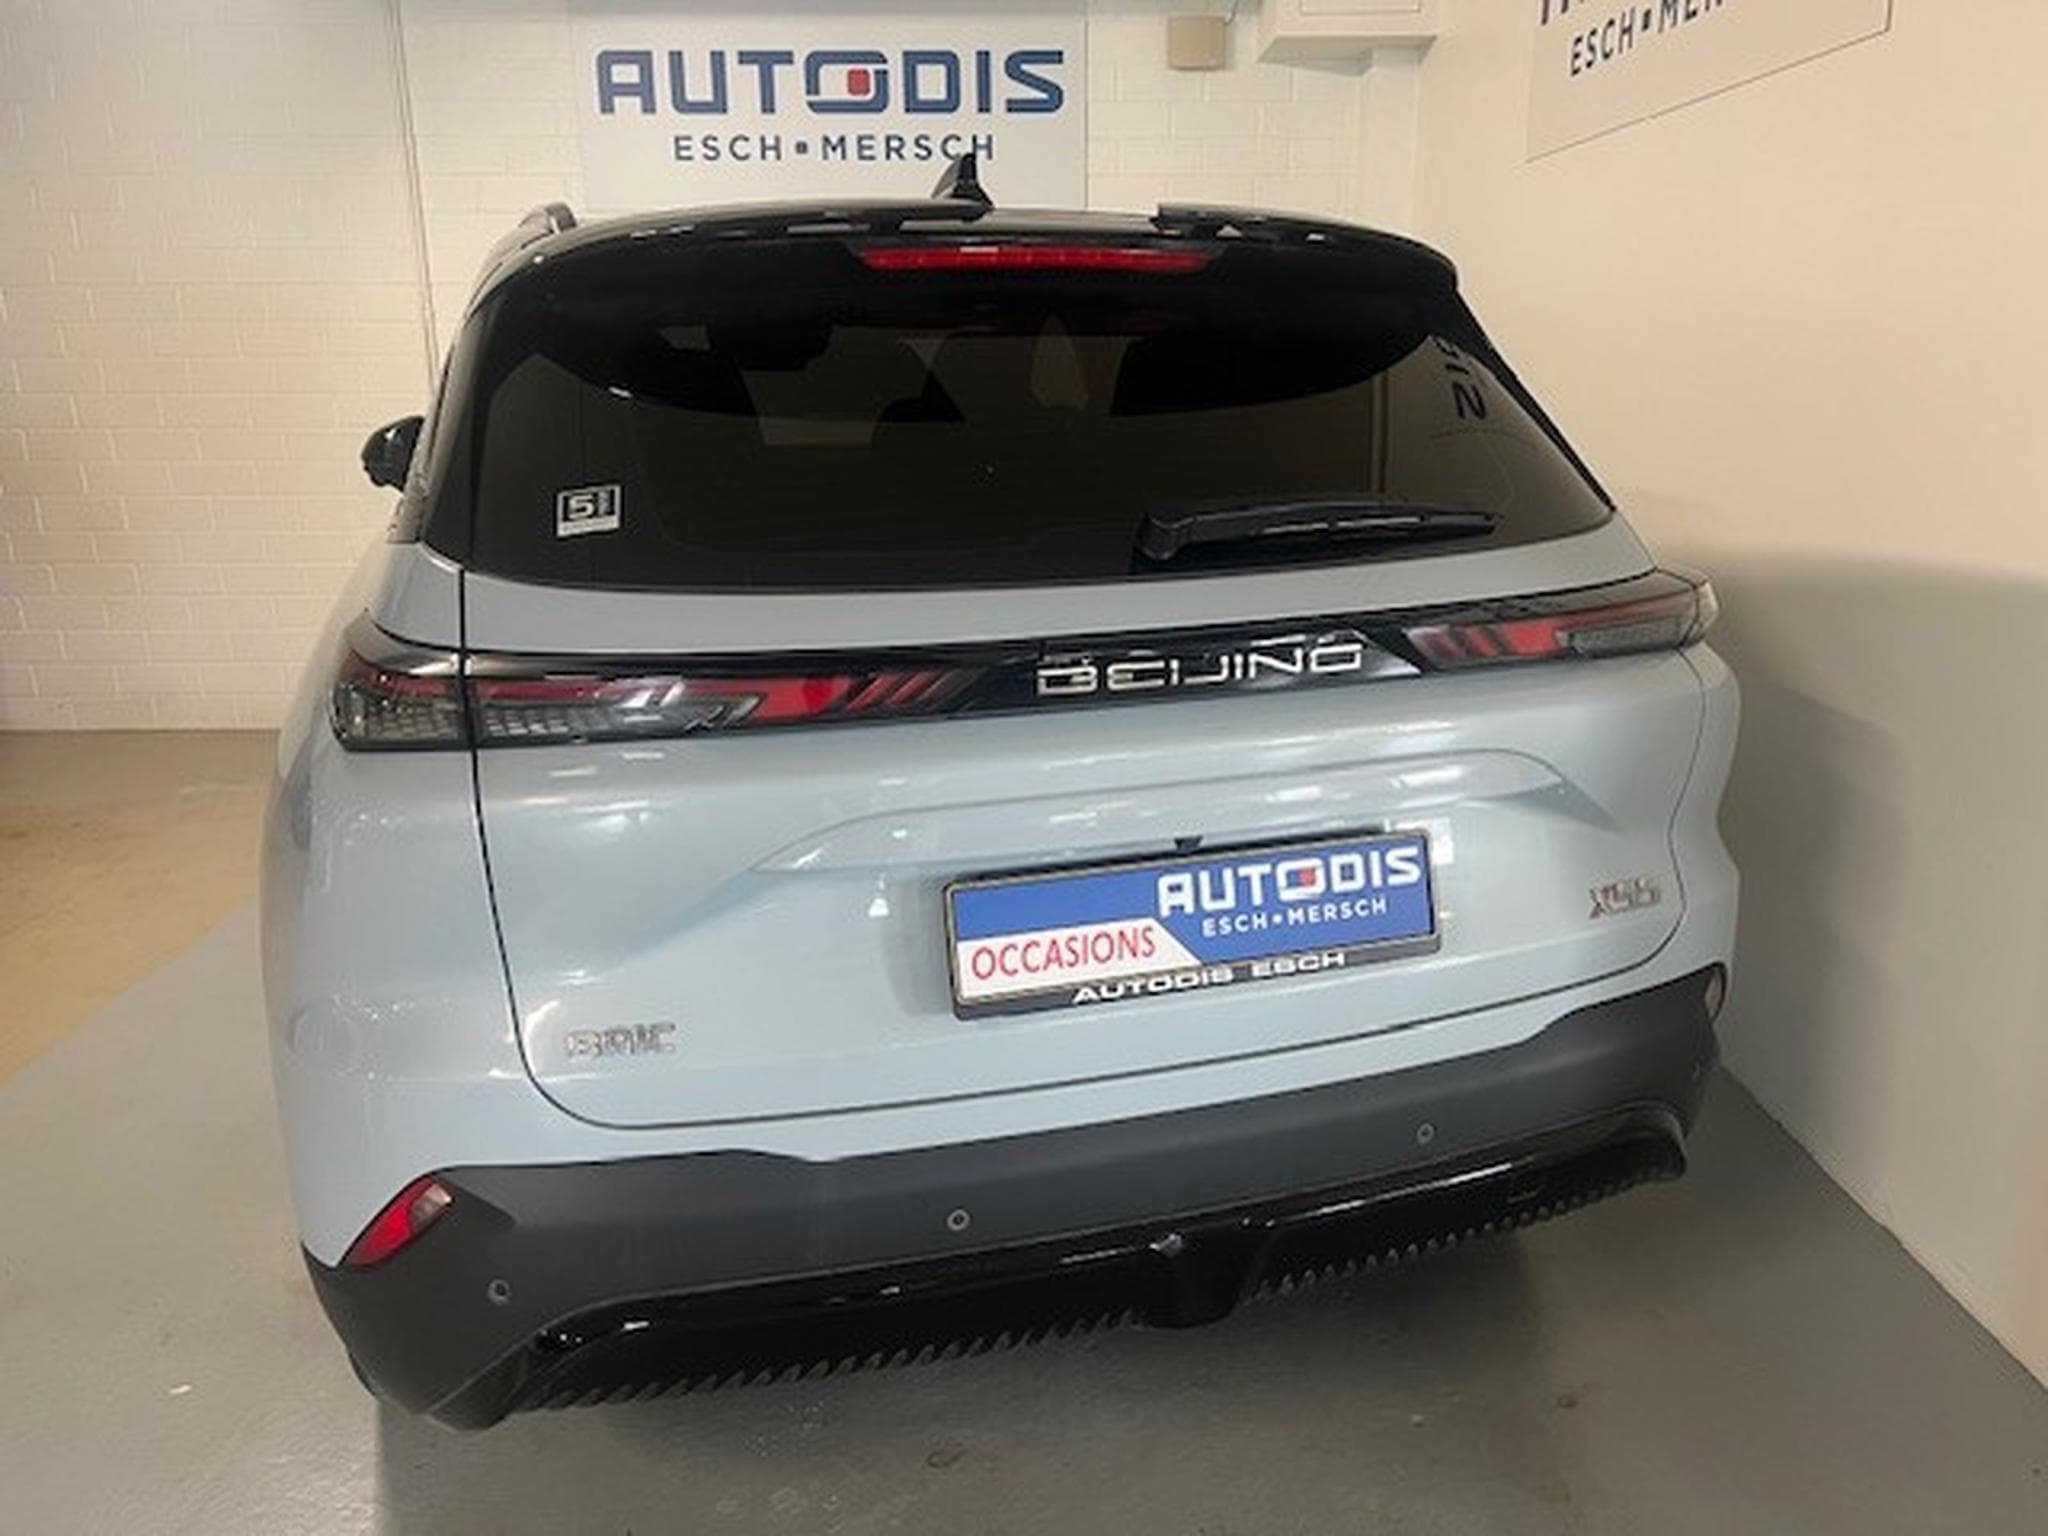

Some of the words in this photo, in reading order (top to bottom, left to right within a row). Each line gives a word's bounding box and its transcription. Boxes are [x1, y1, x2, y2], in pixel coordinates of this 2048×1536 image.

[1571, 7, 1635, 77] ESCH
[596, 50, 1065, 115] AUTODIS
[674, 136, 784, 161] ESCH
[821, 135, 994, 161] MERSCH
[1158, 846, 1421, 917] AUTODIS
[1203, 913, 1268, 938] ESCH
[1288, 896, 1387, 926] MERSCH
[971, 925, 1156, 981] OCCASIONS
[1072, 966, 1235, 1004] AUTODIS
[1250, 950, 1346, 979] ESCH
